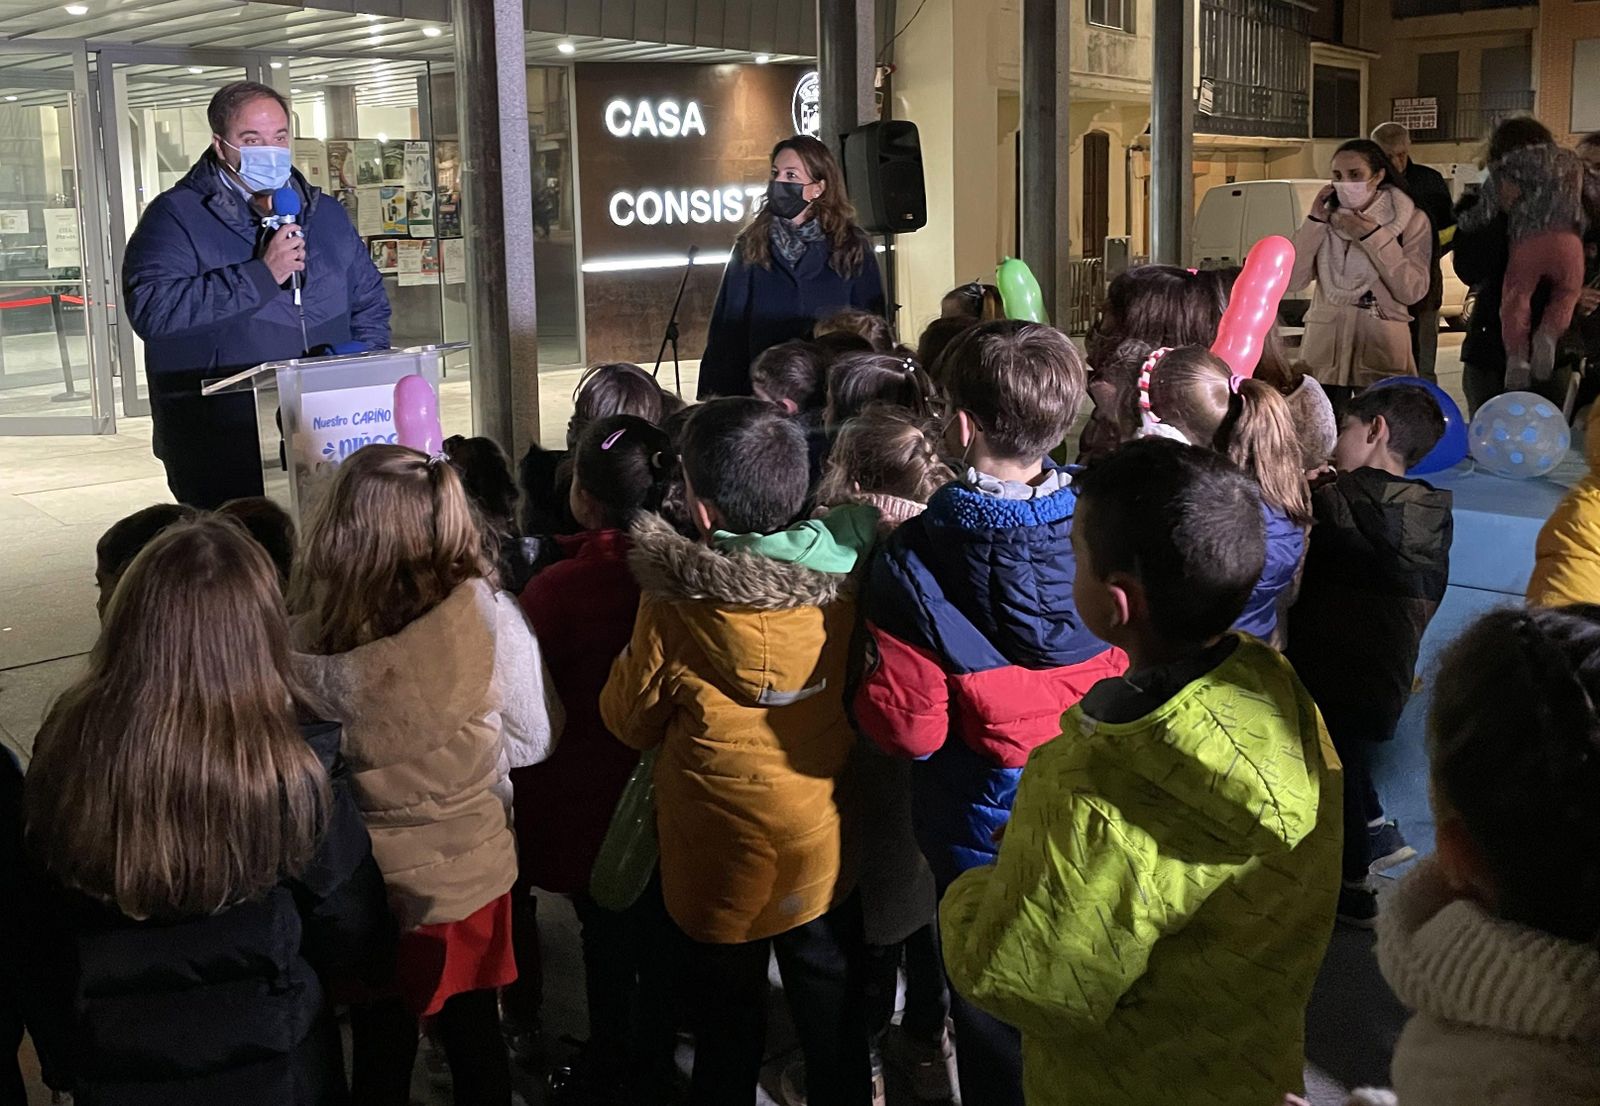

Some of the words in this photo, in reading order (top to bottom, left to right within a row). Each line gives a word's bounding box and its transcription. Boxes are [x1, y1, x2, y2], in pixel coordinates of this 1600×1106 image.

[605, 100, 707, 137] CASA
[313, 414, 348, 431] Nuestro
[352, 407, 392, 425] CARIÑO
